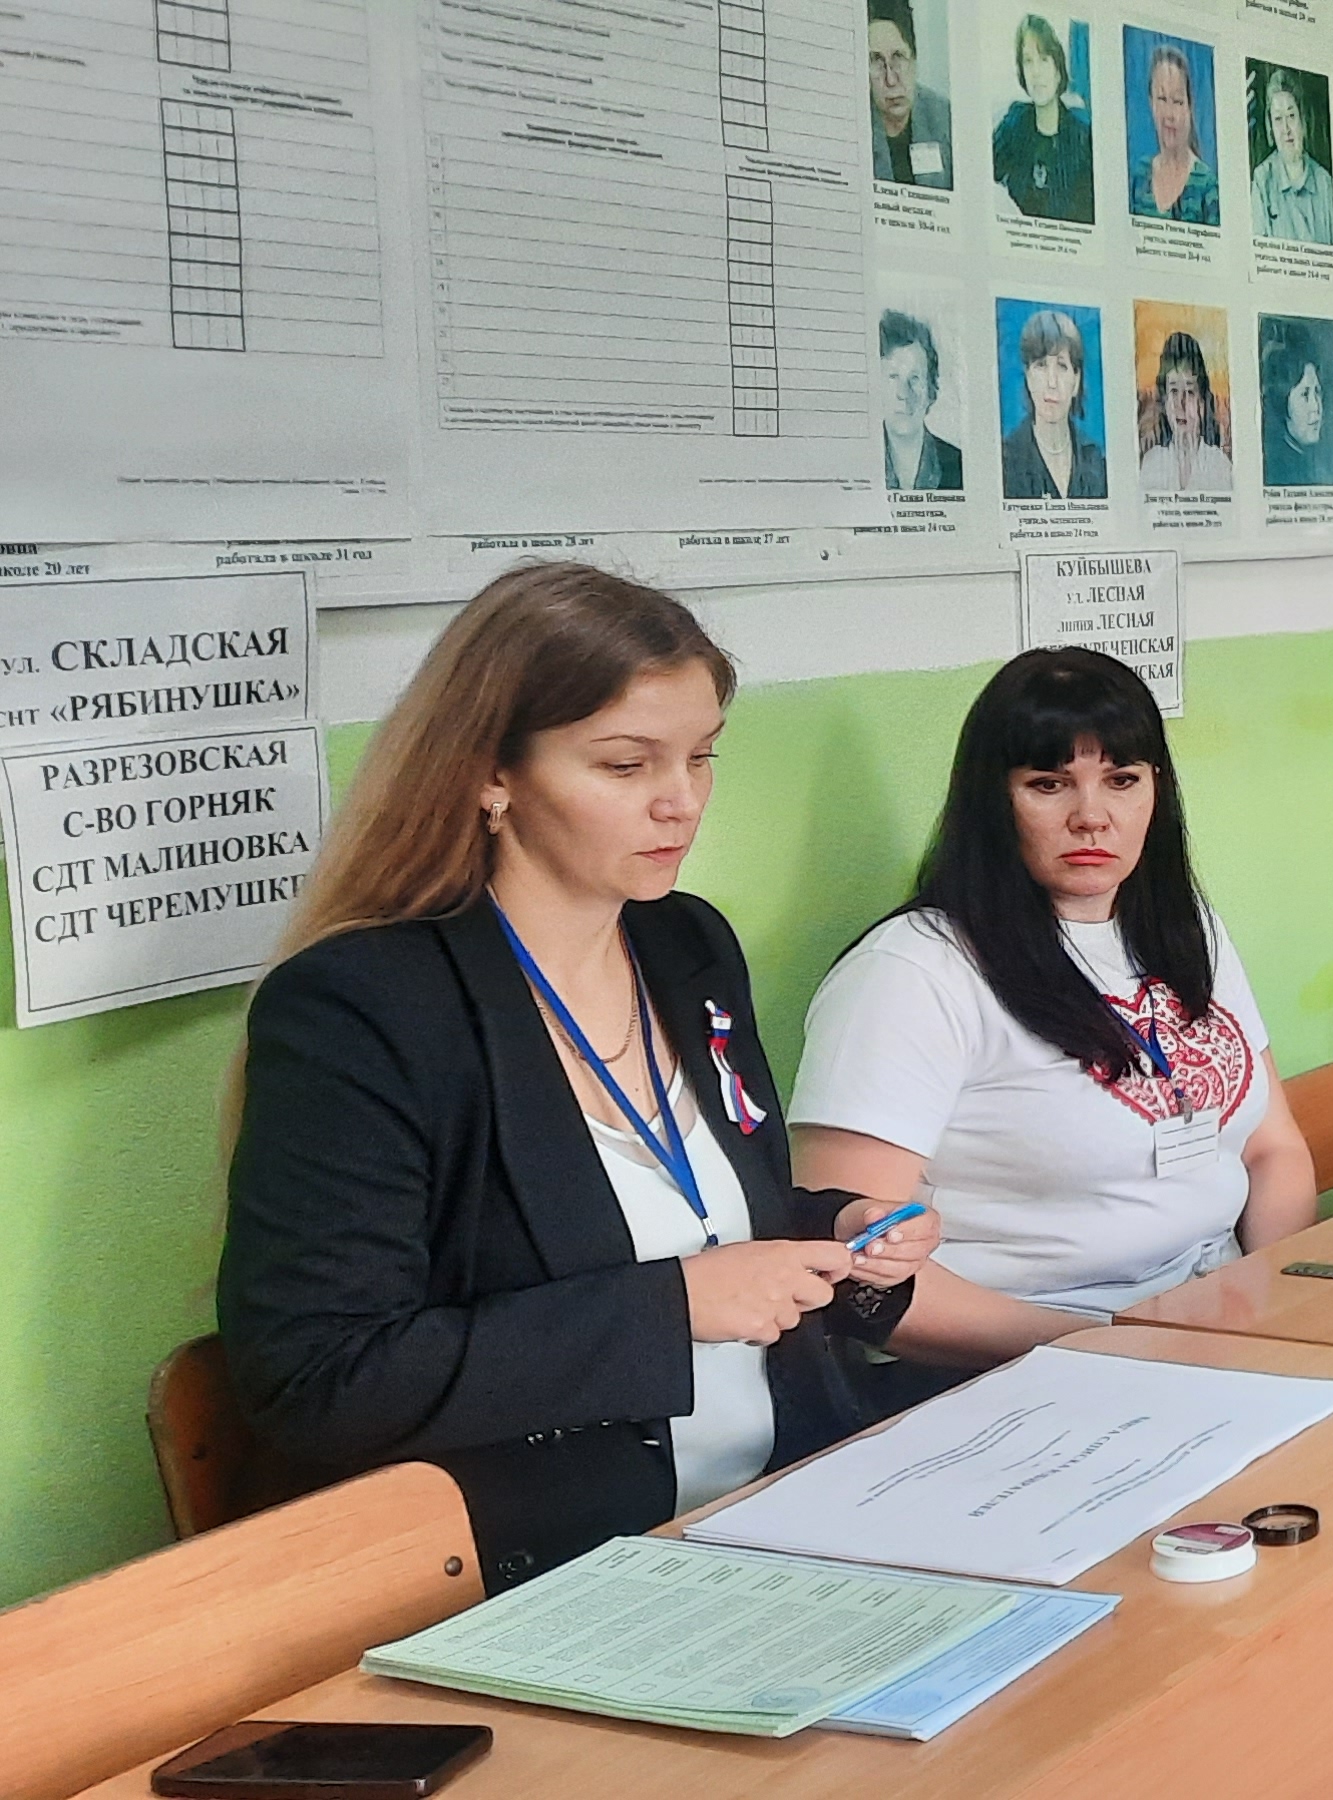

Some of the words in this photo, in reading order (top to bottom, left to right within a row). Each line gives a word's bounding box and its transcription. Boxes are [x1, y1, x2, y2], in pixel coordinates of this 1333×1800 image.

[1056, 557, 1152, 577] КУЙБЫШЕВА
[1086, 585, 1145, 603] ЛЕСНАЯ
[1096, 611, 1155, 630] ЛЕСНАЯ
[1, 657, 40, 676] ул.
[51, 627, 290, 671] СКЛАДСКАЯ
[50, 678, 300, 723] «РЯБИНУШКА»
[40, 740, 288, 792] РАЗРЕЗОВСКАЯ
[63, 804, 137, 838] С-ВО
[146, 787, 276, 827] ГОРНЯК
[32, 858, 95, 896] СДТ
[104, 830, 310, 882] МАЛИНОВКА
[35, 908, 98, 945] СДТ
